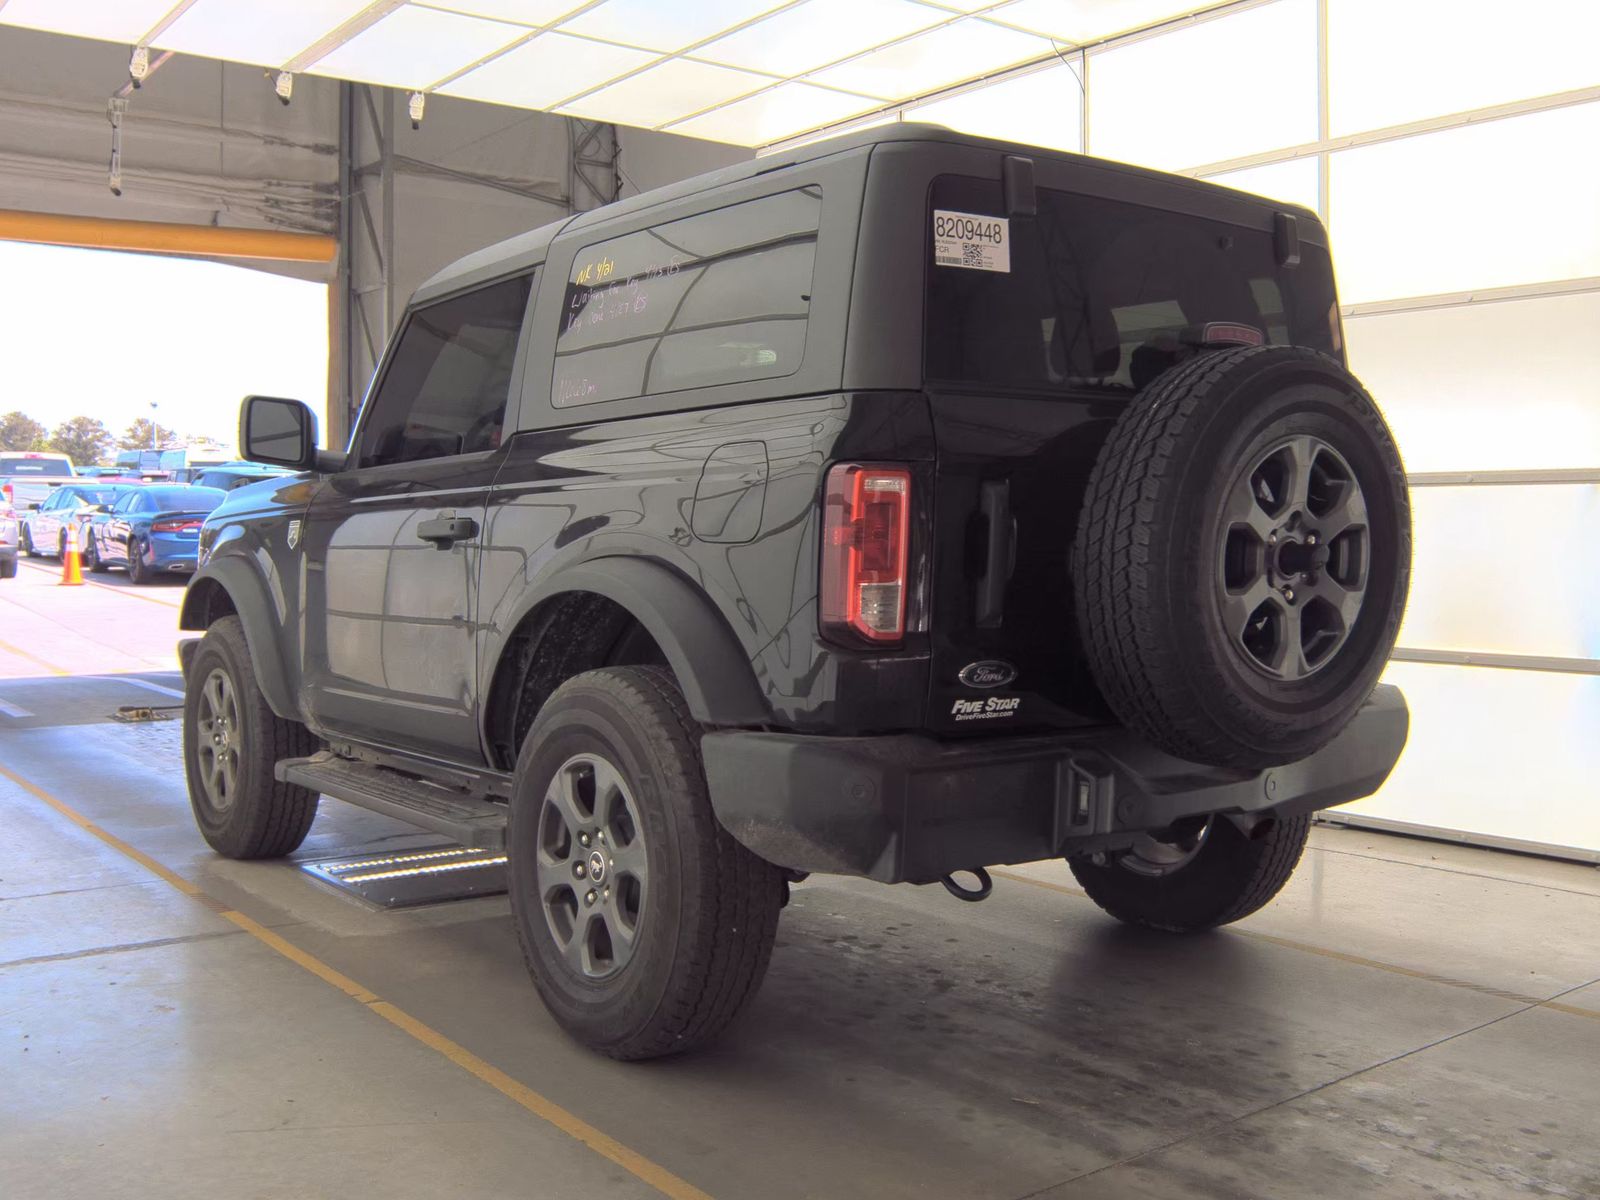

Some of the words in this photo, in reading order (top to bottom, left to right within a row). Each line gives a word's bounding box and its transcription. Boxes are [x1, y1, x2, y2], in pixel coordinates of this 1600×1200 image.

[936, 216, 1002, 244] 8209448
[973, 666, 1004, 682] Ford
[955, 711, 1014, 721] DriveFiveStar.com
